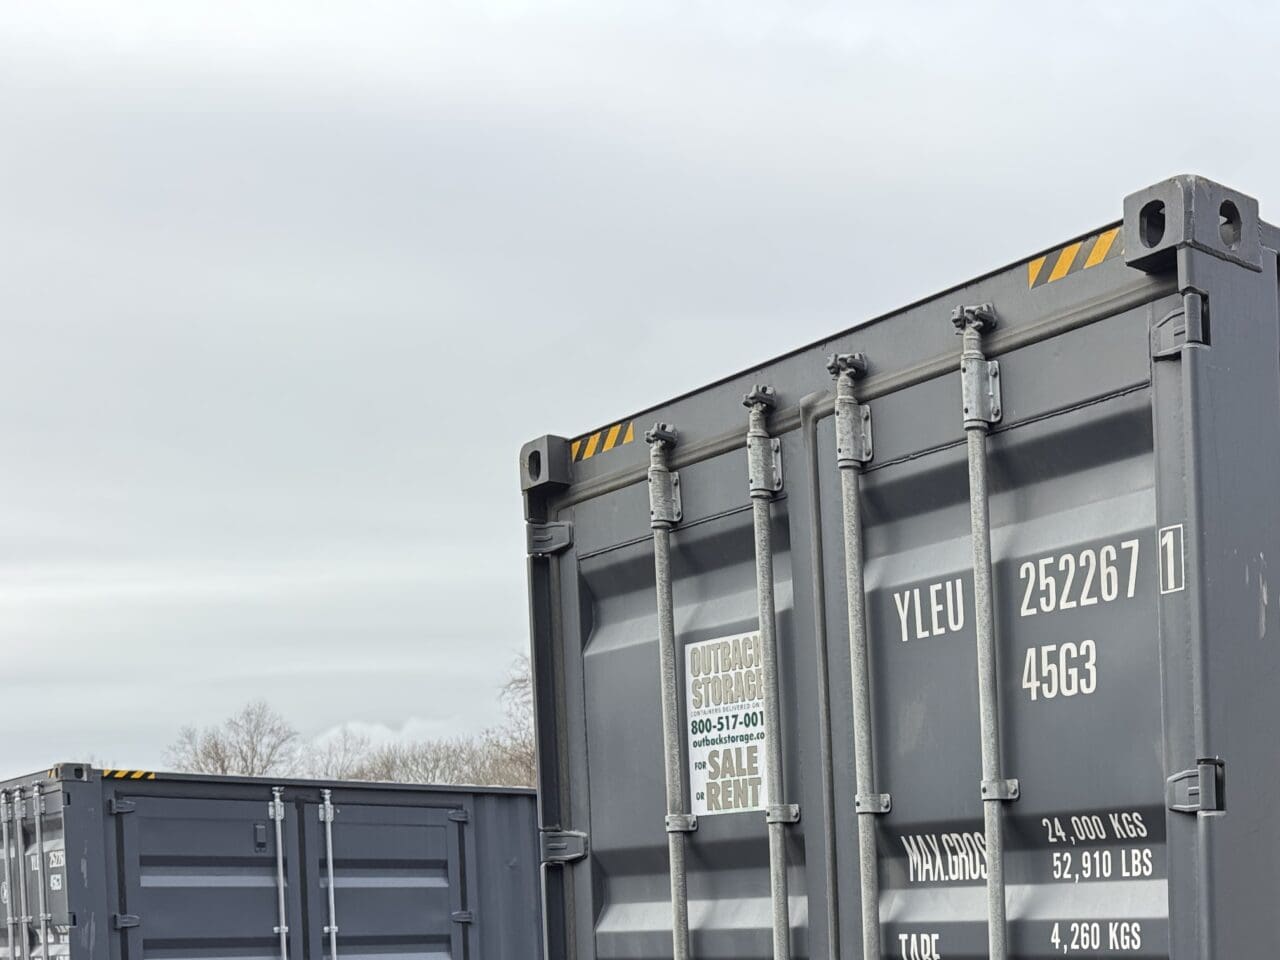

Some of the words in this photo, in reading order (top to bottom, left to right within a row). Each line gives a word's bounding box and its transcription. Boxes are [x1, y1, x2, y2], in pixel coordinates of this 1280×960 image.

[893, 578, 965, 642] YLEU
[1019, 538, 1140, 617] 252267
[1160, 528, 1178, 591] 1
[1022, 639, 1097, 701] 45G3
[691, 669, 763, 709] STORAGE
[691, 711, 764, 735] 800-517-001
[692, 731, 765, 748] outbackstorage.co
[694, 761, 707, 771] FOR
[708, 746, 759, 780] SALE
[696, 791, 705, 801] OR
[706, 777, 761, 811] RENT
[1042, 814, 1107, 845] 24,000
[1109, 811, 1148, 839] KGS
[900, 831, 988, 882] MAX.GROS
[1052, 850, 1112, 883] 52,910
[1121, 848, 1152, 877] LBS
[1050, 922, 1100, 954] 4,260
[1109, 922, 1142, 950] KGS
